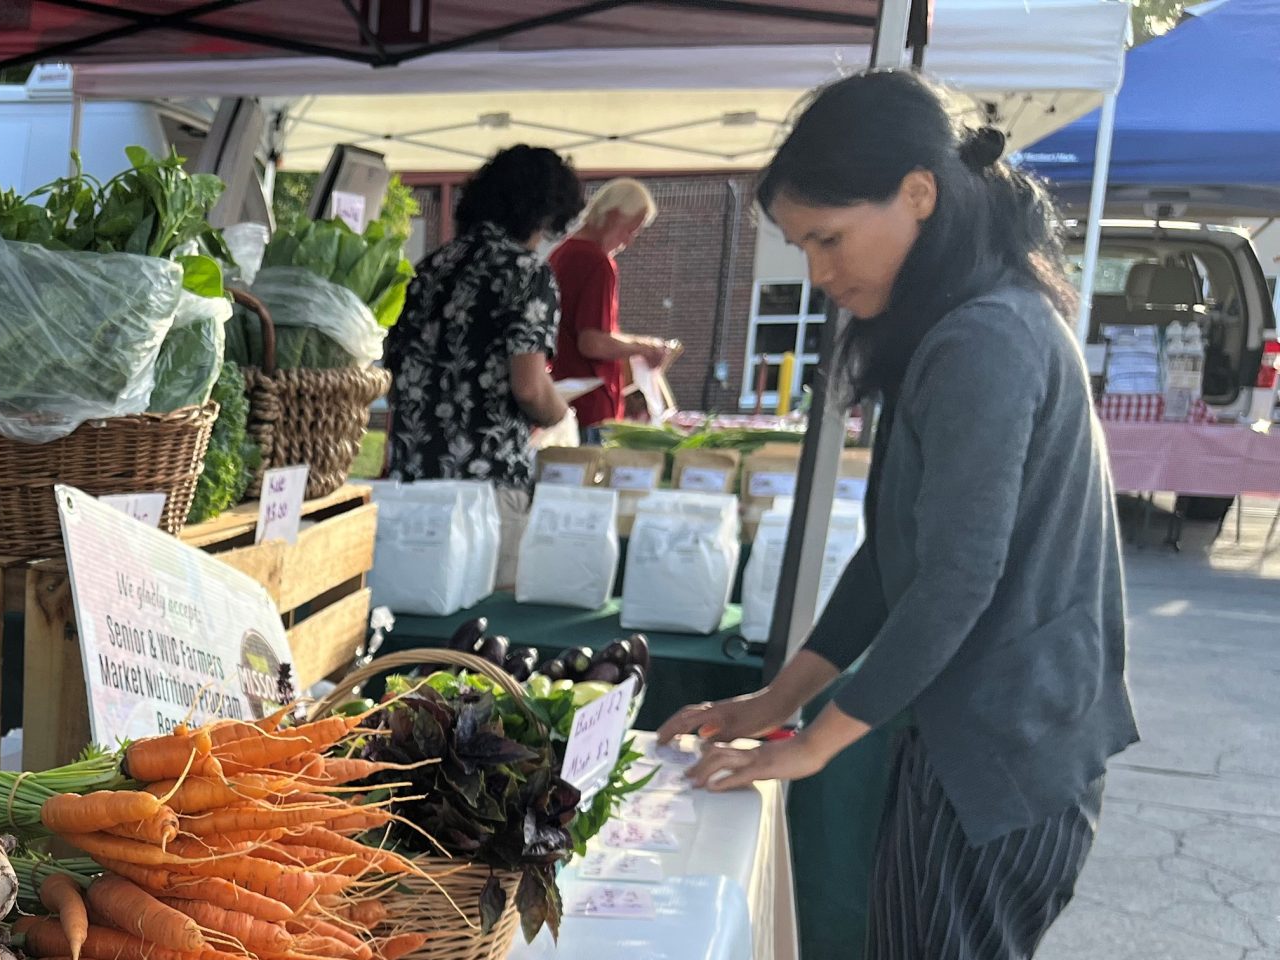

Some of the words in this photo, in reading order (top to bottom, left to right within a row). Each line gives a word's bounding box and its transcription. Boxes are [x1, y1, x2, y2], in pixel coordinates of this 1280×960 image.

[116, 570, 134, 598] We
[137, 578, 165, 618] gladly
[106, 614, 146, 657] Senior
[147, 629, 158, 660] &
[156, 631, 181, 666] WIC
[180, 639, 225, 681] Farmers
[98, 653, 145, 697] Market
[144, 666, 198, 711] Nutrition
[196, 682, 243, 722] Program
